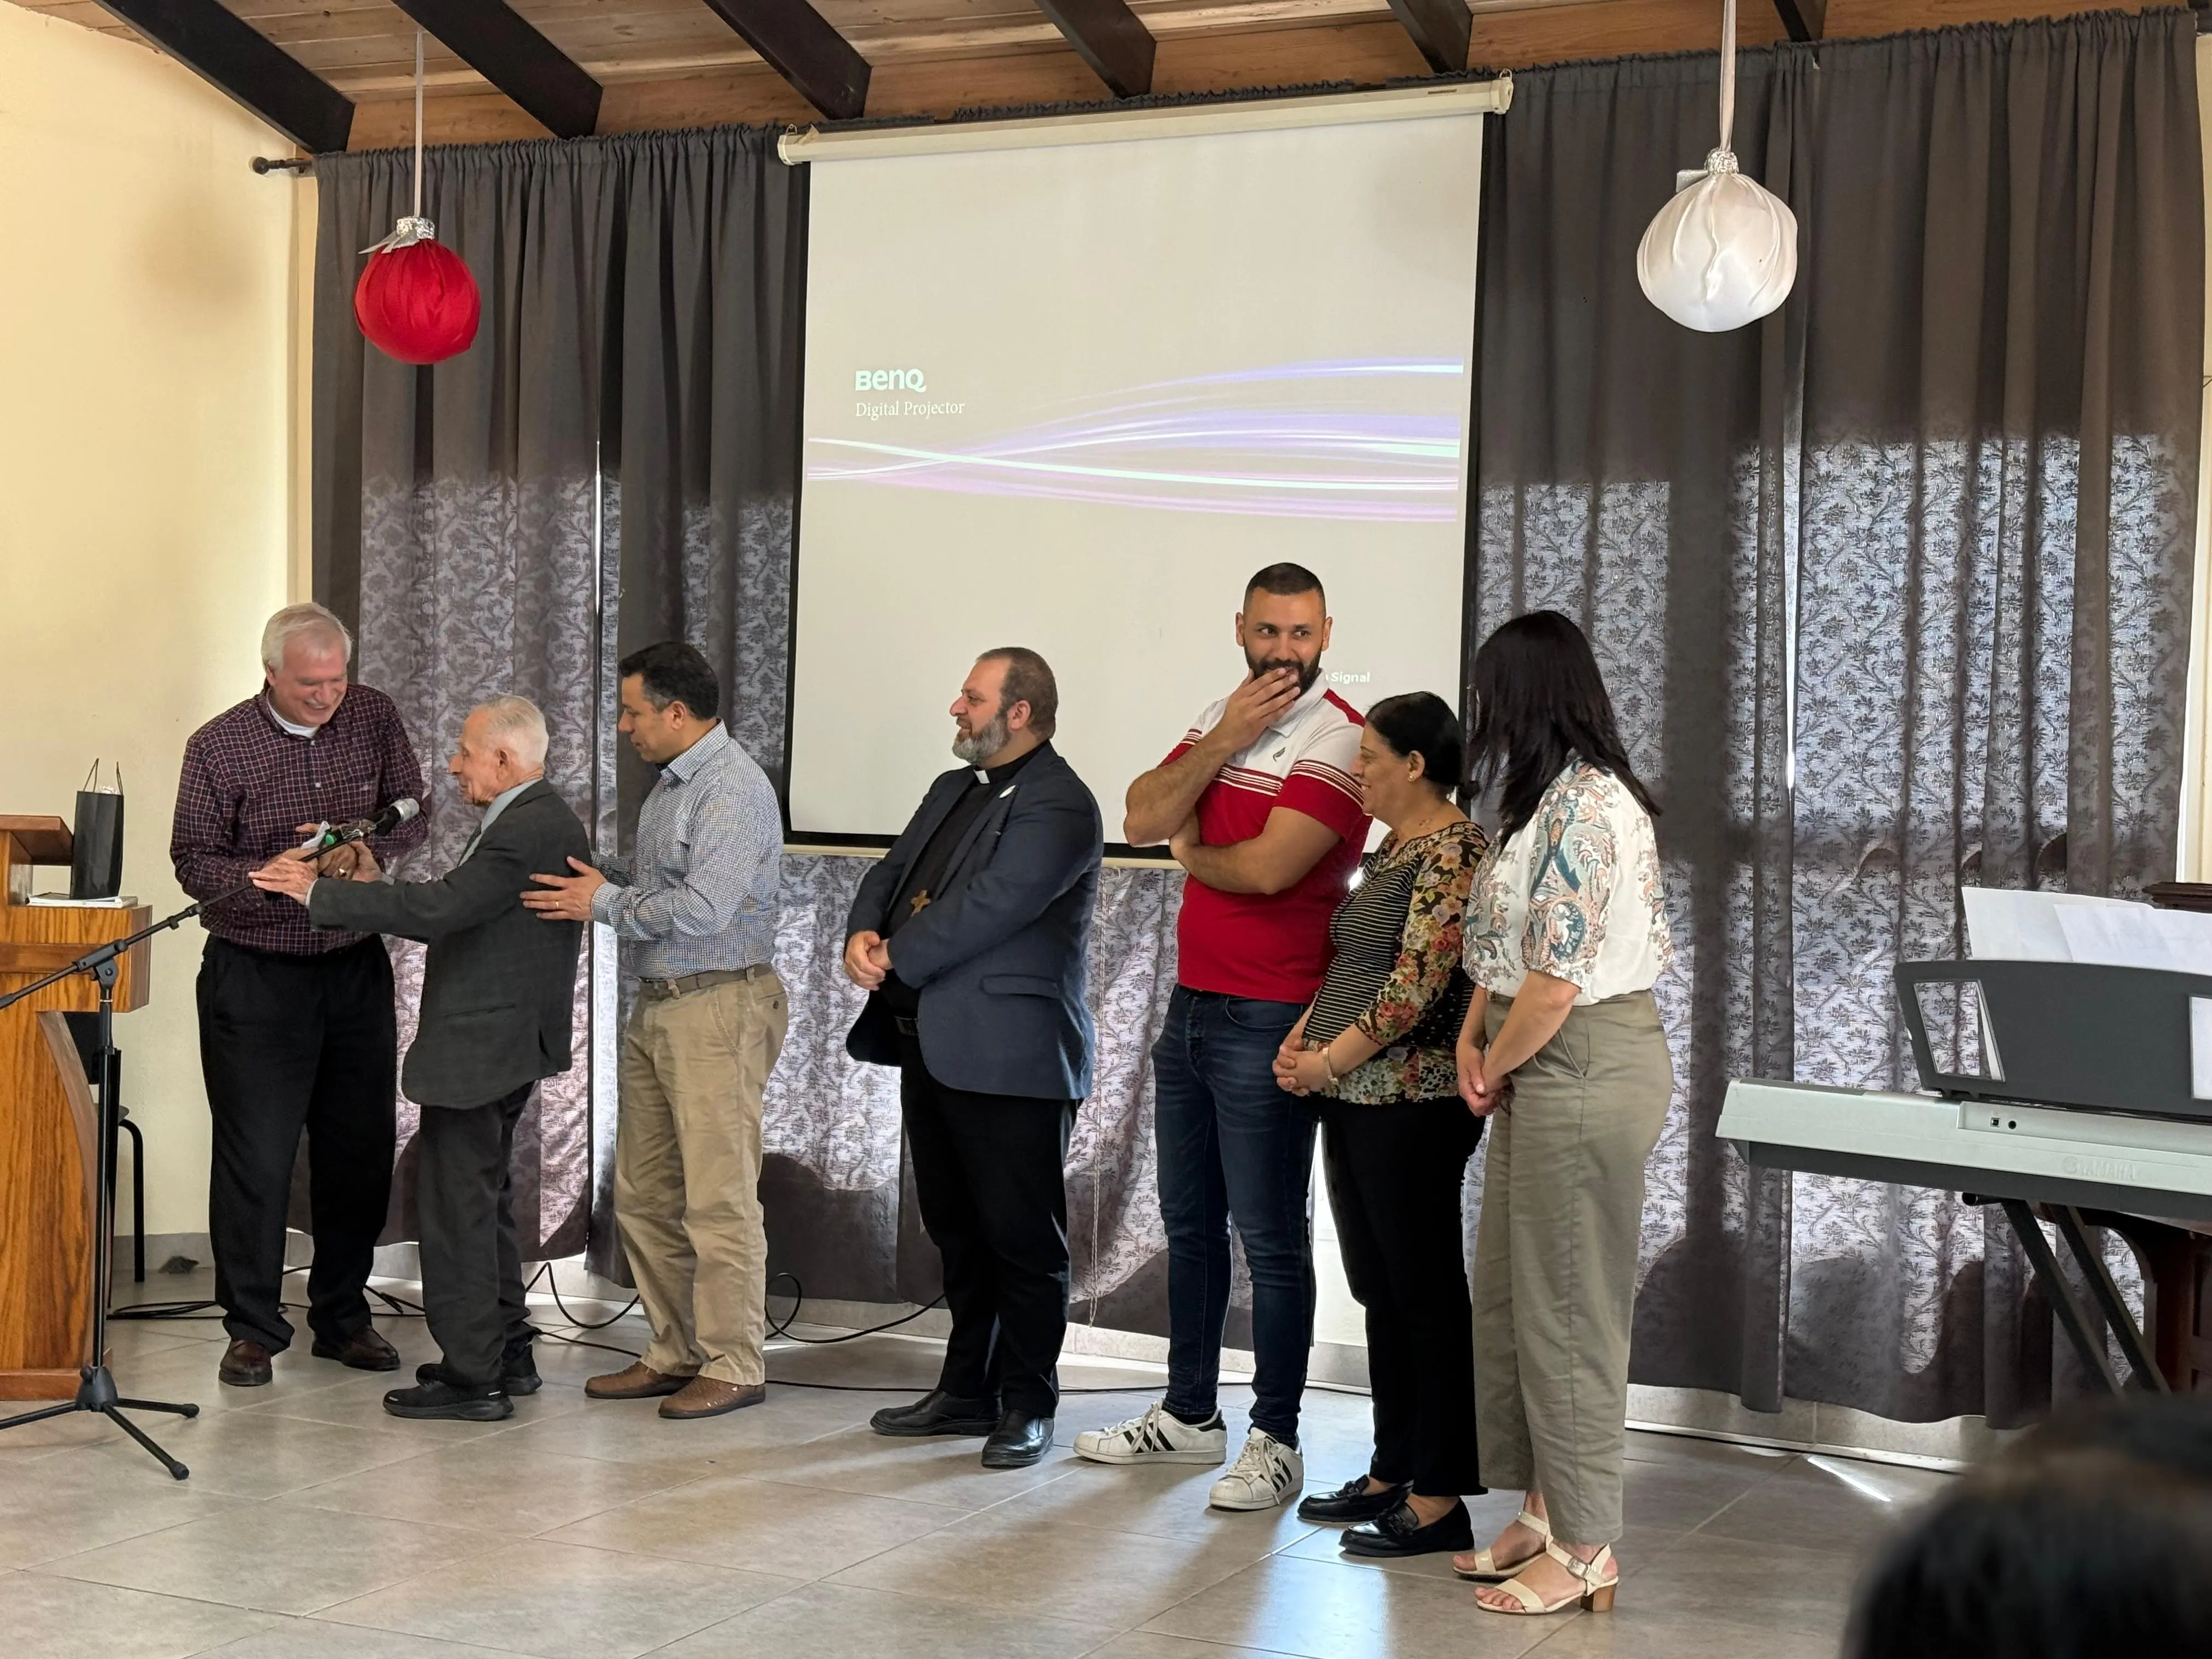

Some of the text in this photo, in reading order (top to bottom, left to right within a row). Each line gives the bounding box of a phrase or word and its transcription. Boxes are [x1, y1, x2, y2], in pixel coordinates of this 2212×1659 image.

[855, 368, 927, 393] BenQ
[855, 400, 965, 421] Digital Projector
[1330, 671, 1370, 684] Signal
